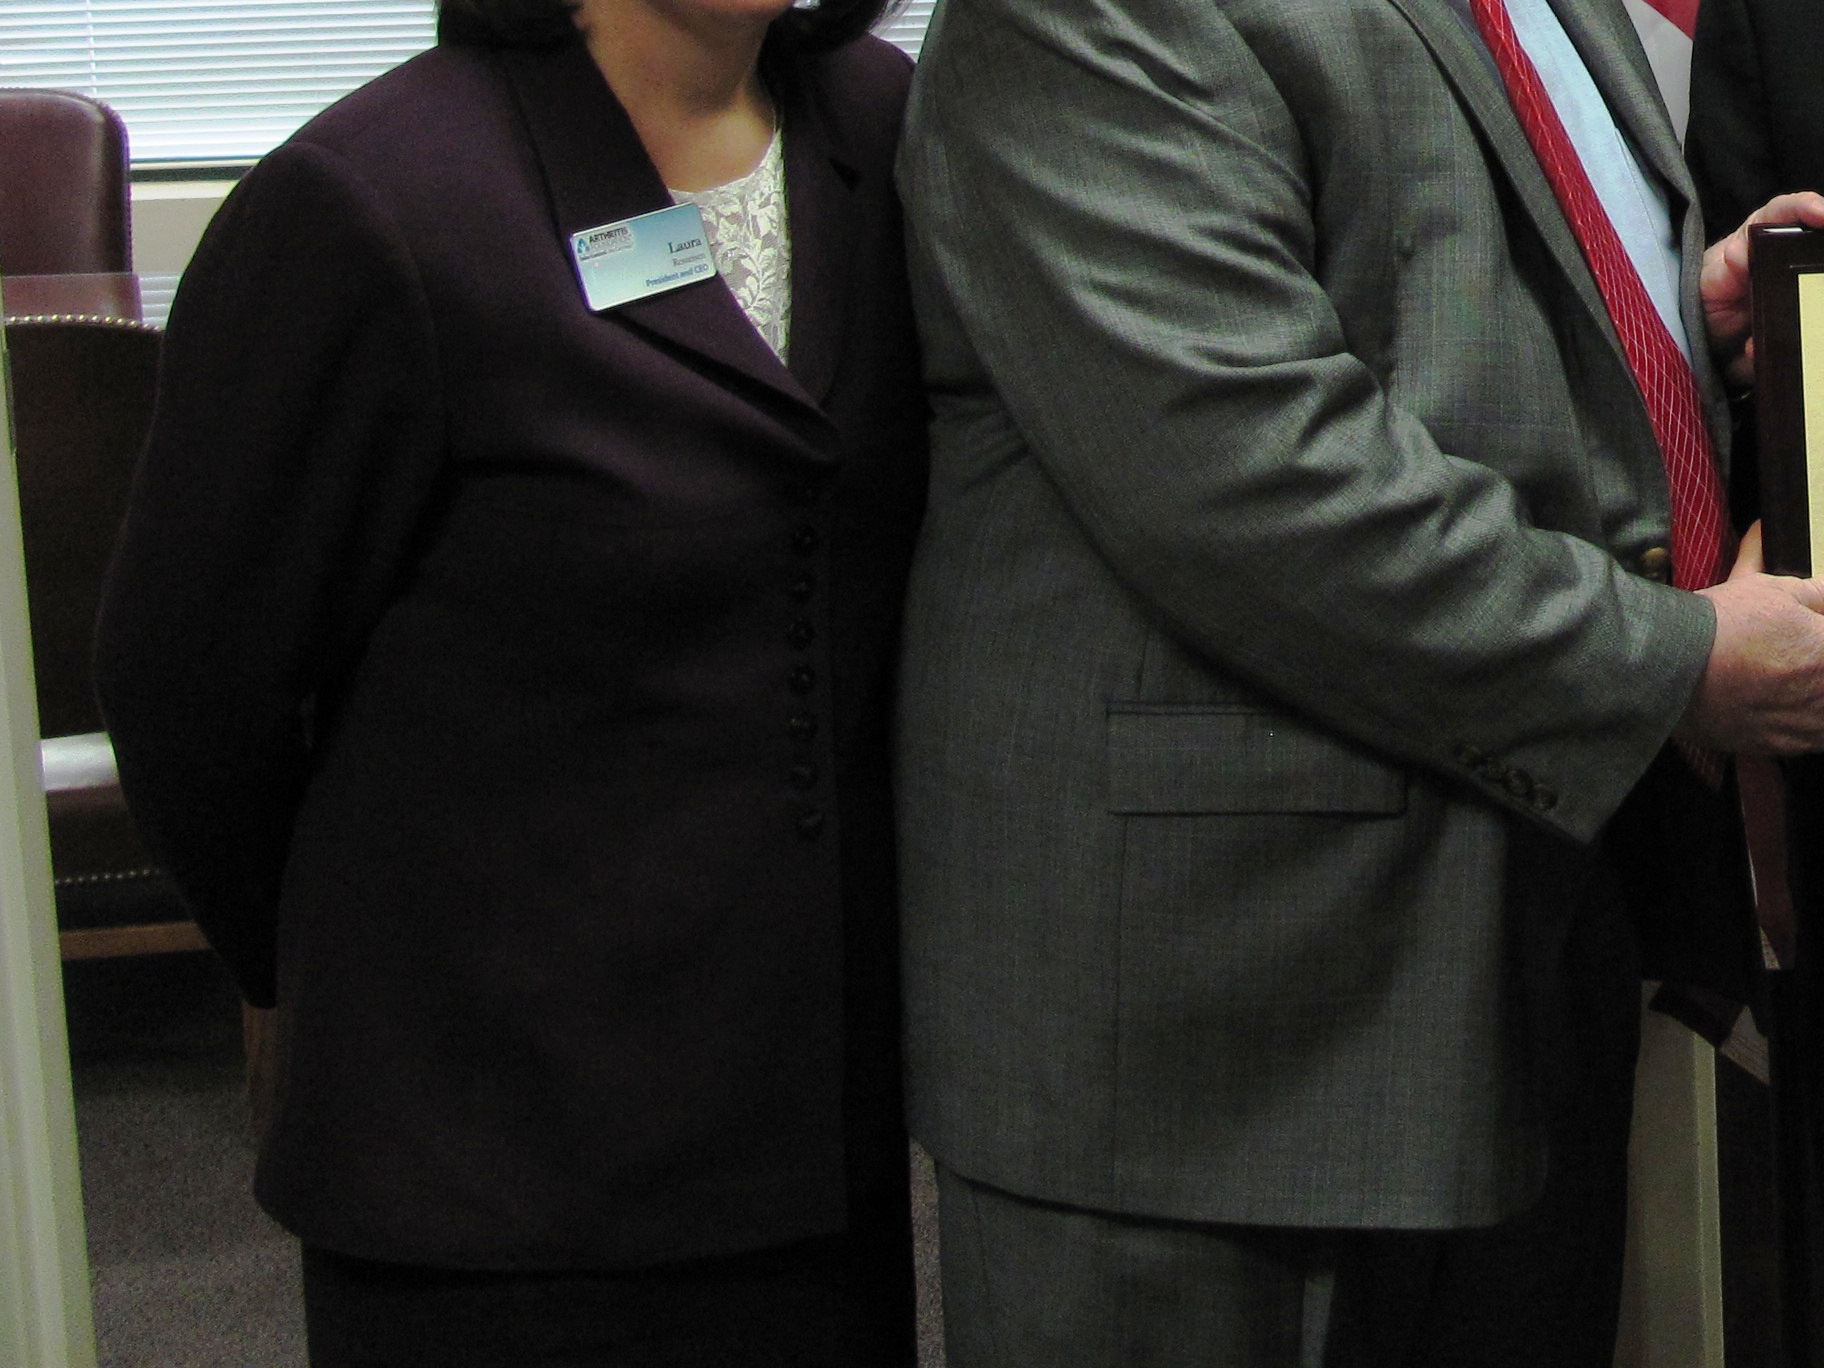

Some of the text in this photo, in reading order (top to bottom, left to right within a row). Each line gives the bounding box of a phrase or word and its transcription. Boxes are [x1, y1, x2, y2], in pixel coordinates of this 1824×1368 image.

[589, 226, 629, 243] ARTHRITIS
[667, 238, 702, 253] Laura
[646, 272, 680, 287] President
[694, 264, 708, 273] CEO
